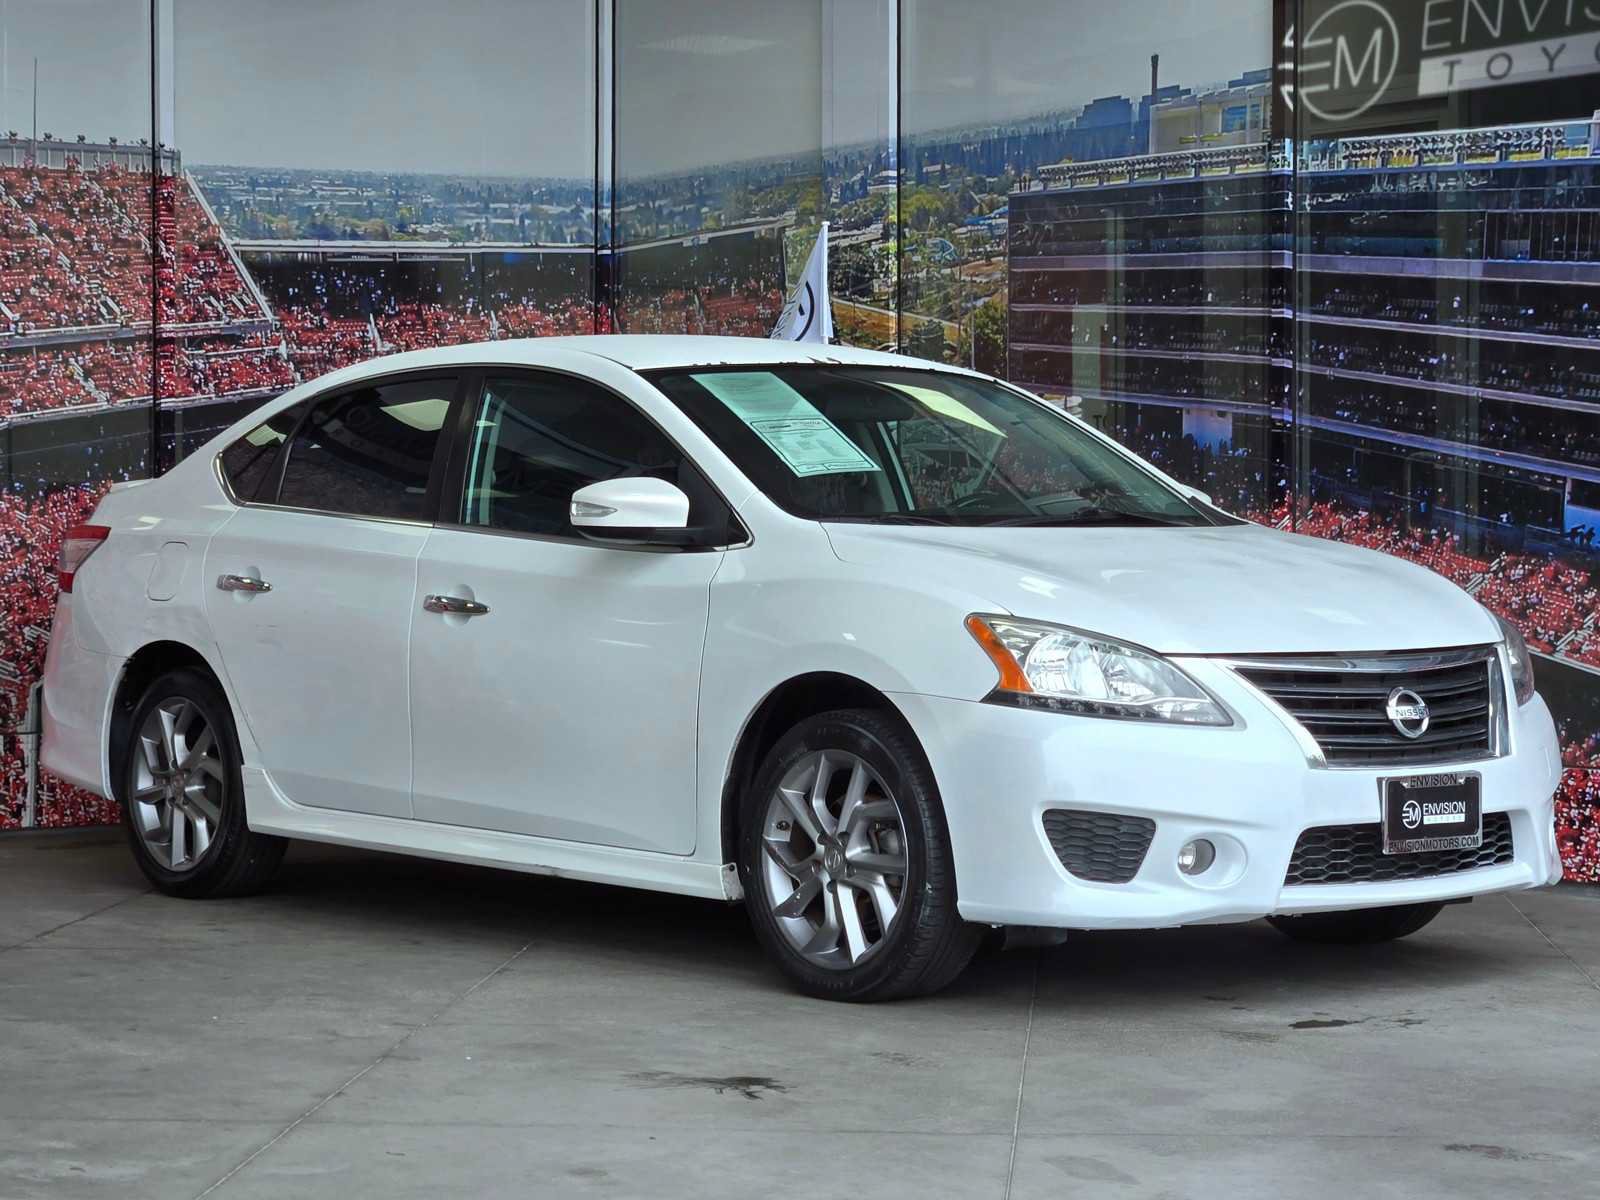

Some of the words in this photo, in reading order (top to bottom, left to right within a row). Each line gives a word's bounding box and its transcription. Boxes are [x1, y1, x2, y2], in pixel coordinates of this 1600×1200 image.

[1443, 42, 1600, 87] TOY
[1410, 774, 1457, 787] ENVISION
[1423, 801, 1465, 815] ENVISION
[1388, 836, 1479, 851] ENVISIONMOTORS.COM
